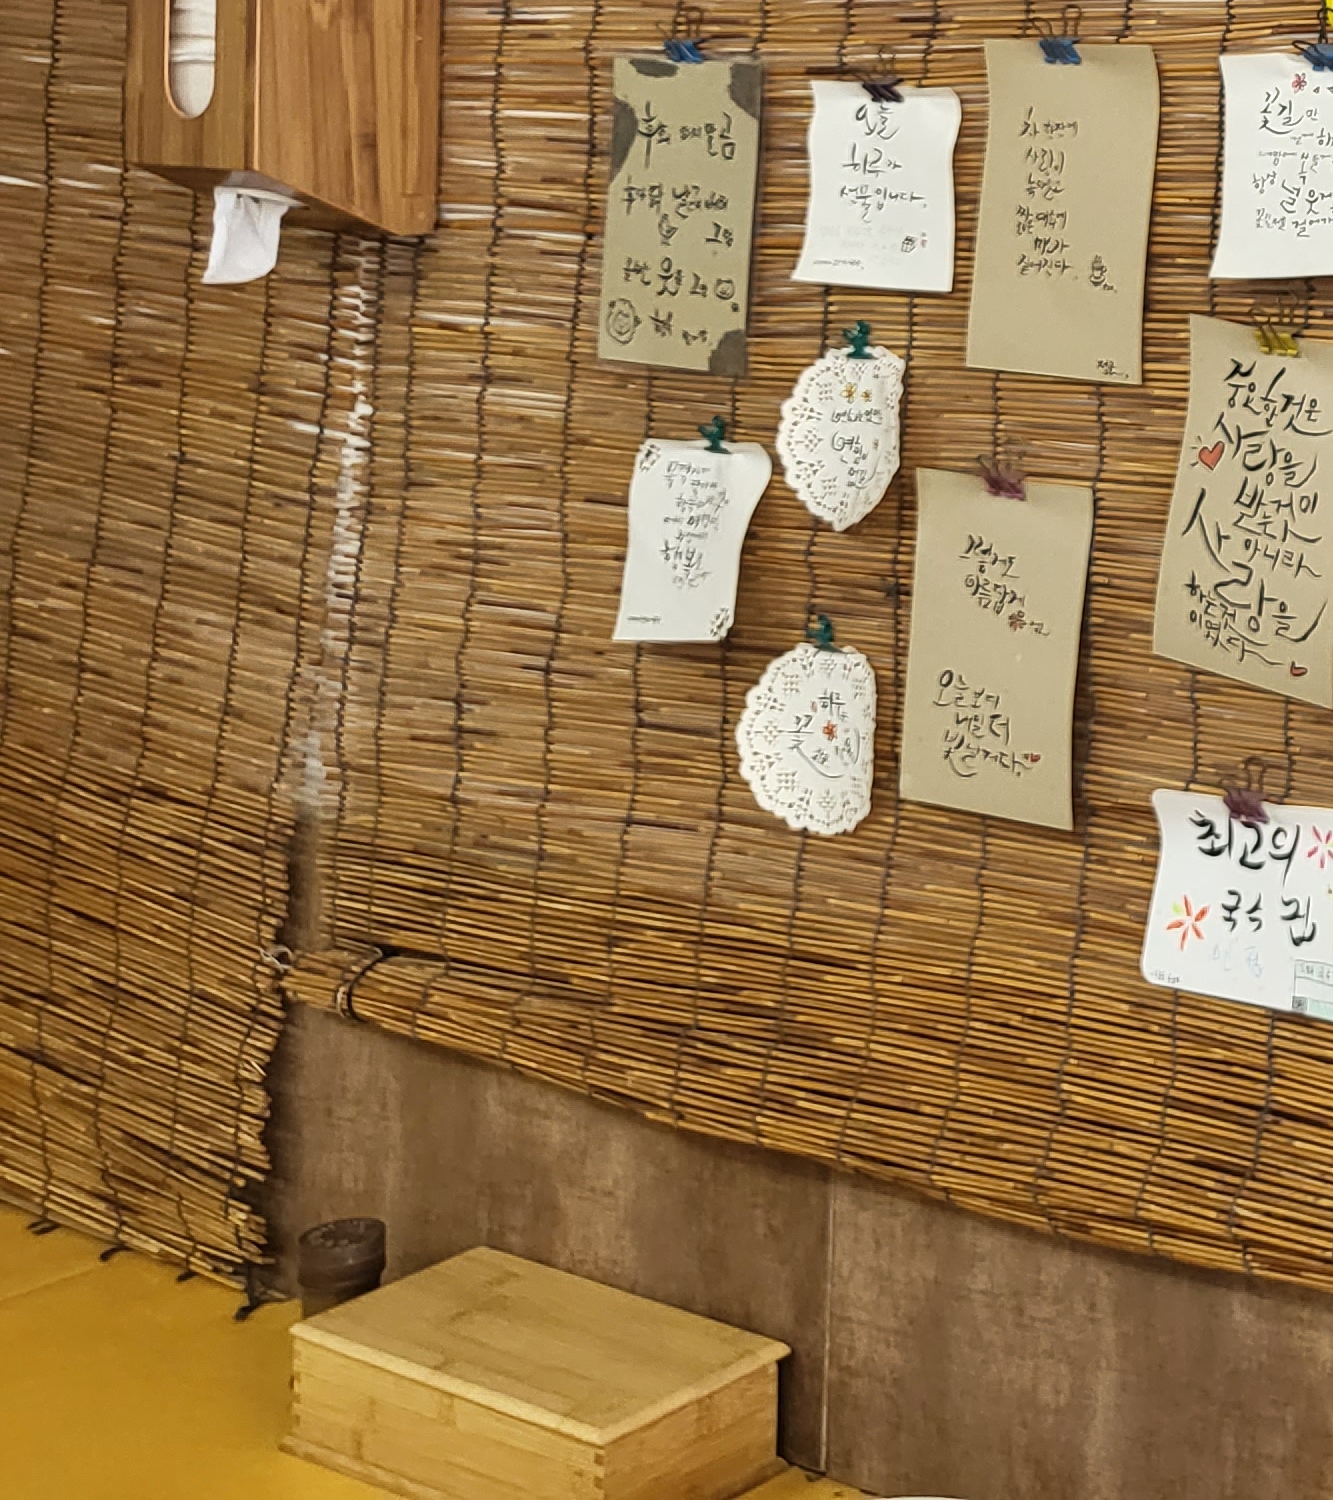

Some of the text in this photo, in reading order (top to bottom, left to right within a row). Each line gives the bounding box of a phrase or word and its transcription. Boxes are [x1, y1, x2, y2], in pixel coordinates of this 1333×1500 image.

[1213, 411, 1319, 490] 사랑을
[1244, 537, 1323, 578] 아니라
[1187, 808, 1302, 889] 최고의
